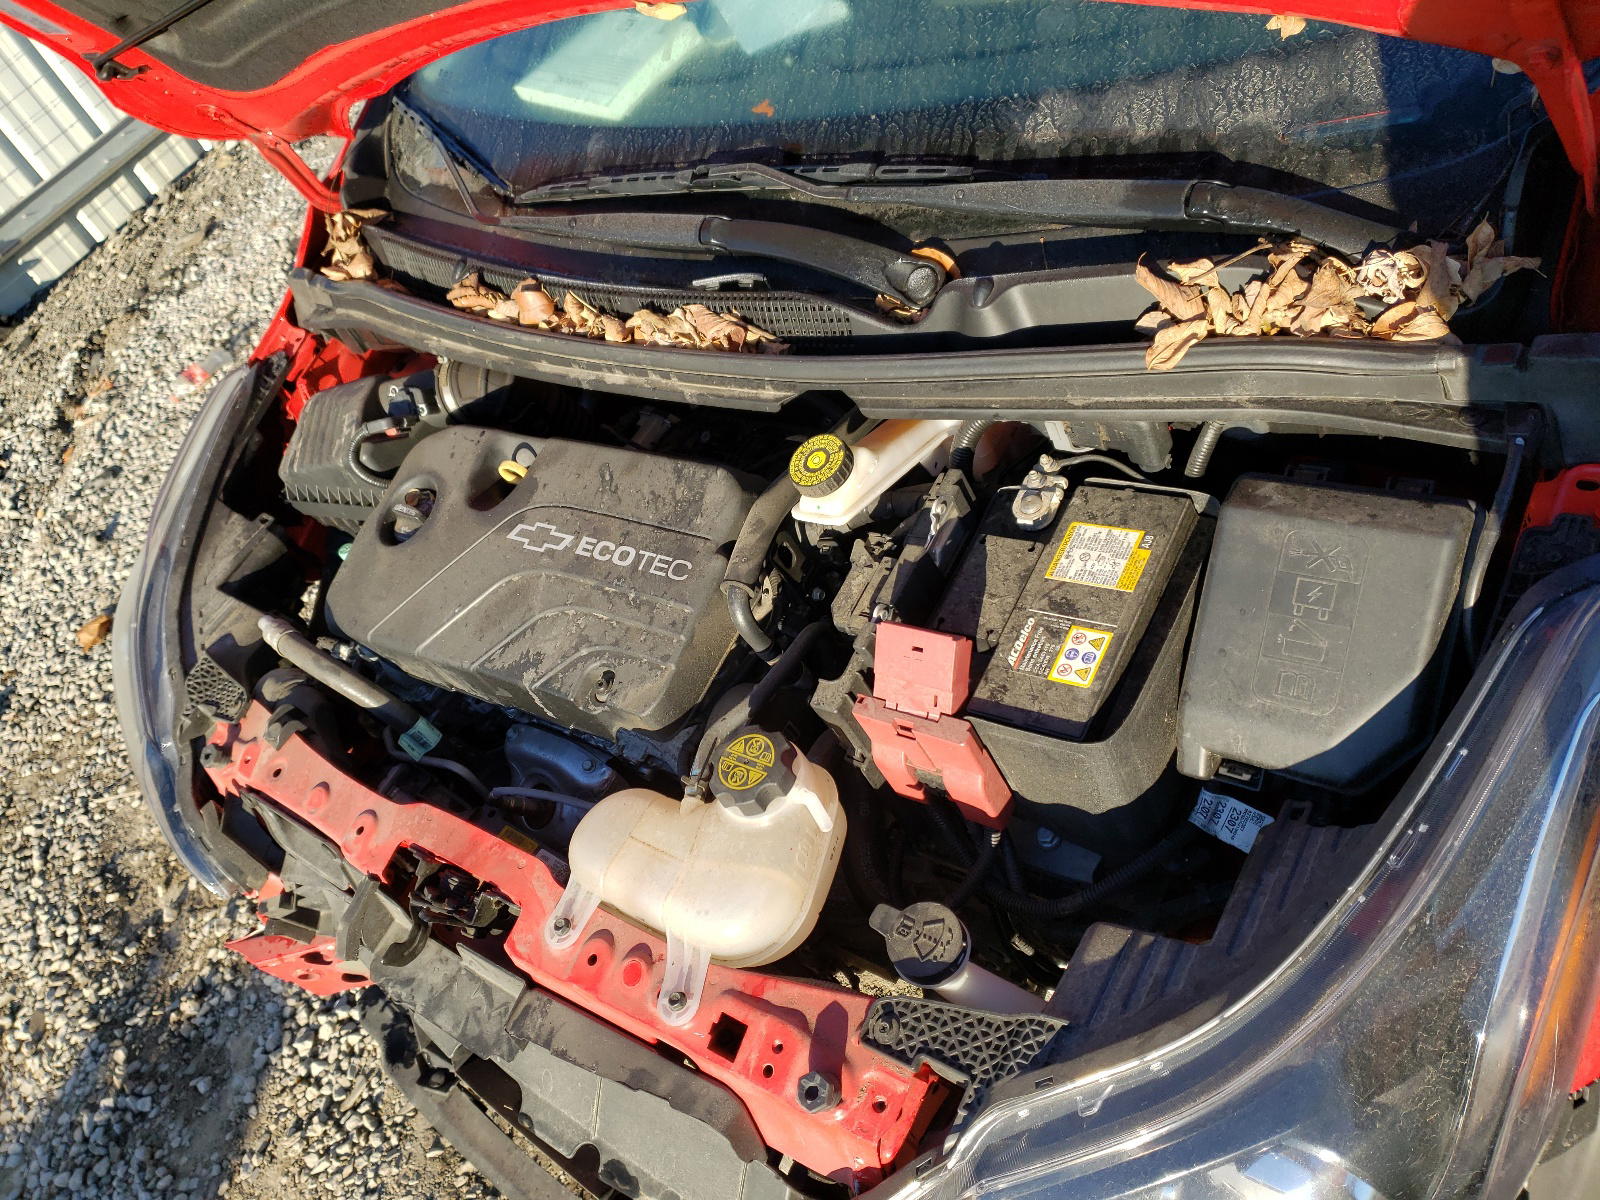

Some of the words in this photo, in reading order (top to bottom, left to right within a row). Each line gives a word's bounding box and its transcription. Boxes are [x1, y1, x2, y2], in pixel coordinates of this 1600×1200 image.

[575, 536, 693, 581] ECOTEC
[1141, 534, 1154, 549] AJ8
[1007, 617, 1035, 667] ACDelco
[1225, 807, 1242, 833] 2307
